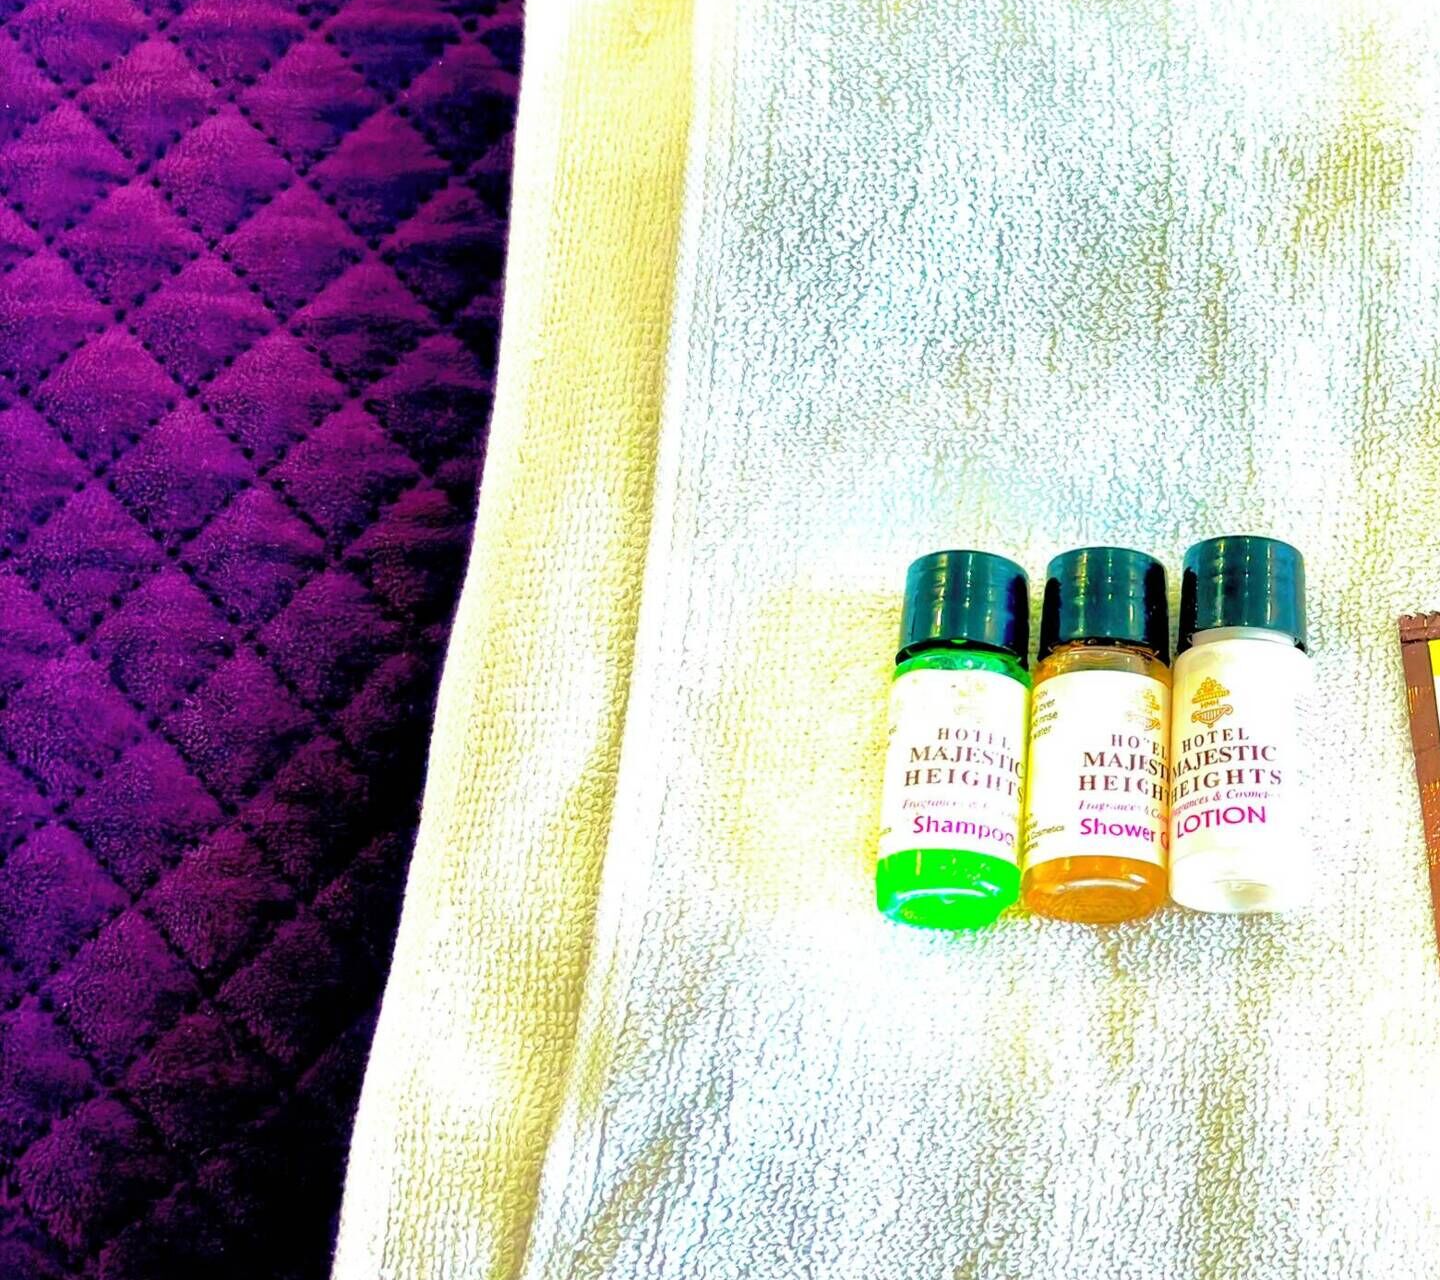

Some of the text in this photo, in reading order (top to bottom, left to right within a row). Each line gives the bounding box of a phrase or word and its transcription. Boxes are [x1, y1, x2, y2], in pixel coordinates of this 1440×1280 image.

[1111, 734, 1167, 760] HOEL
[1182, 727, 1249, 754] HOTEL
[910, 745, 1024, 779] MAJESTIC
[1173, 745, 1277, 782] MAJESTIC
[904, 768, 1024, 804] HEIGHTS
[1078, 775, 1170, 807] HEIGHT
[1171, 768, 1282, 806] HEIGHTS
[1226, 788, 1279, 800] Cosmet
[912, 815, 1015, 847] Shampoo
[1080, 818, 1156, 843] Shower
[1177, 805, 1266, 839] LOTION
